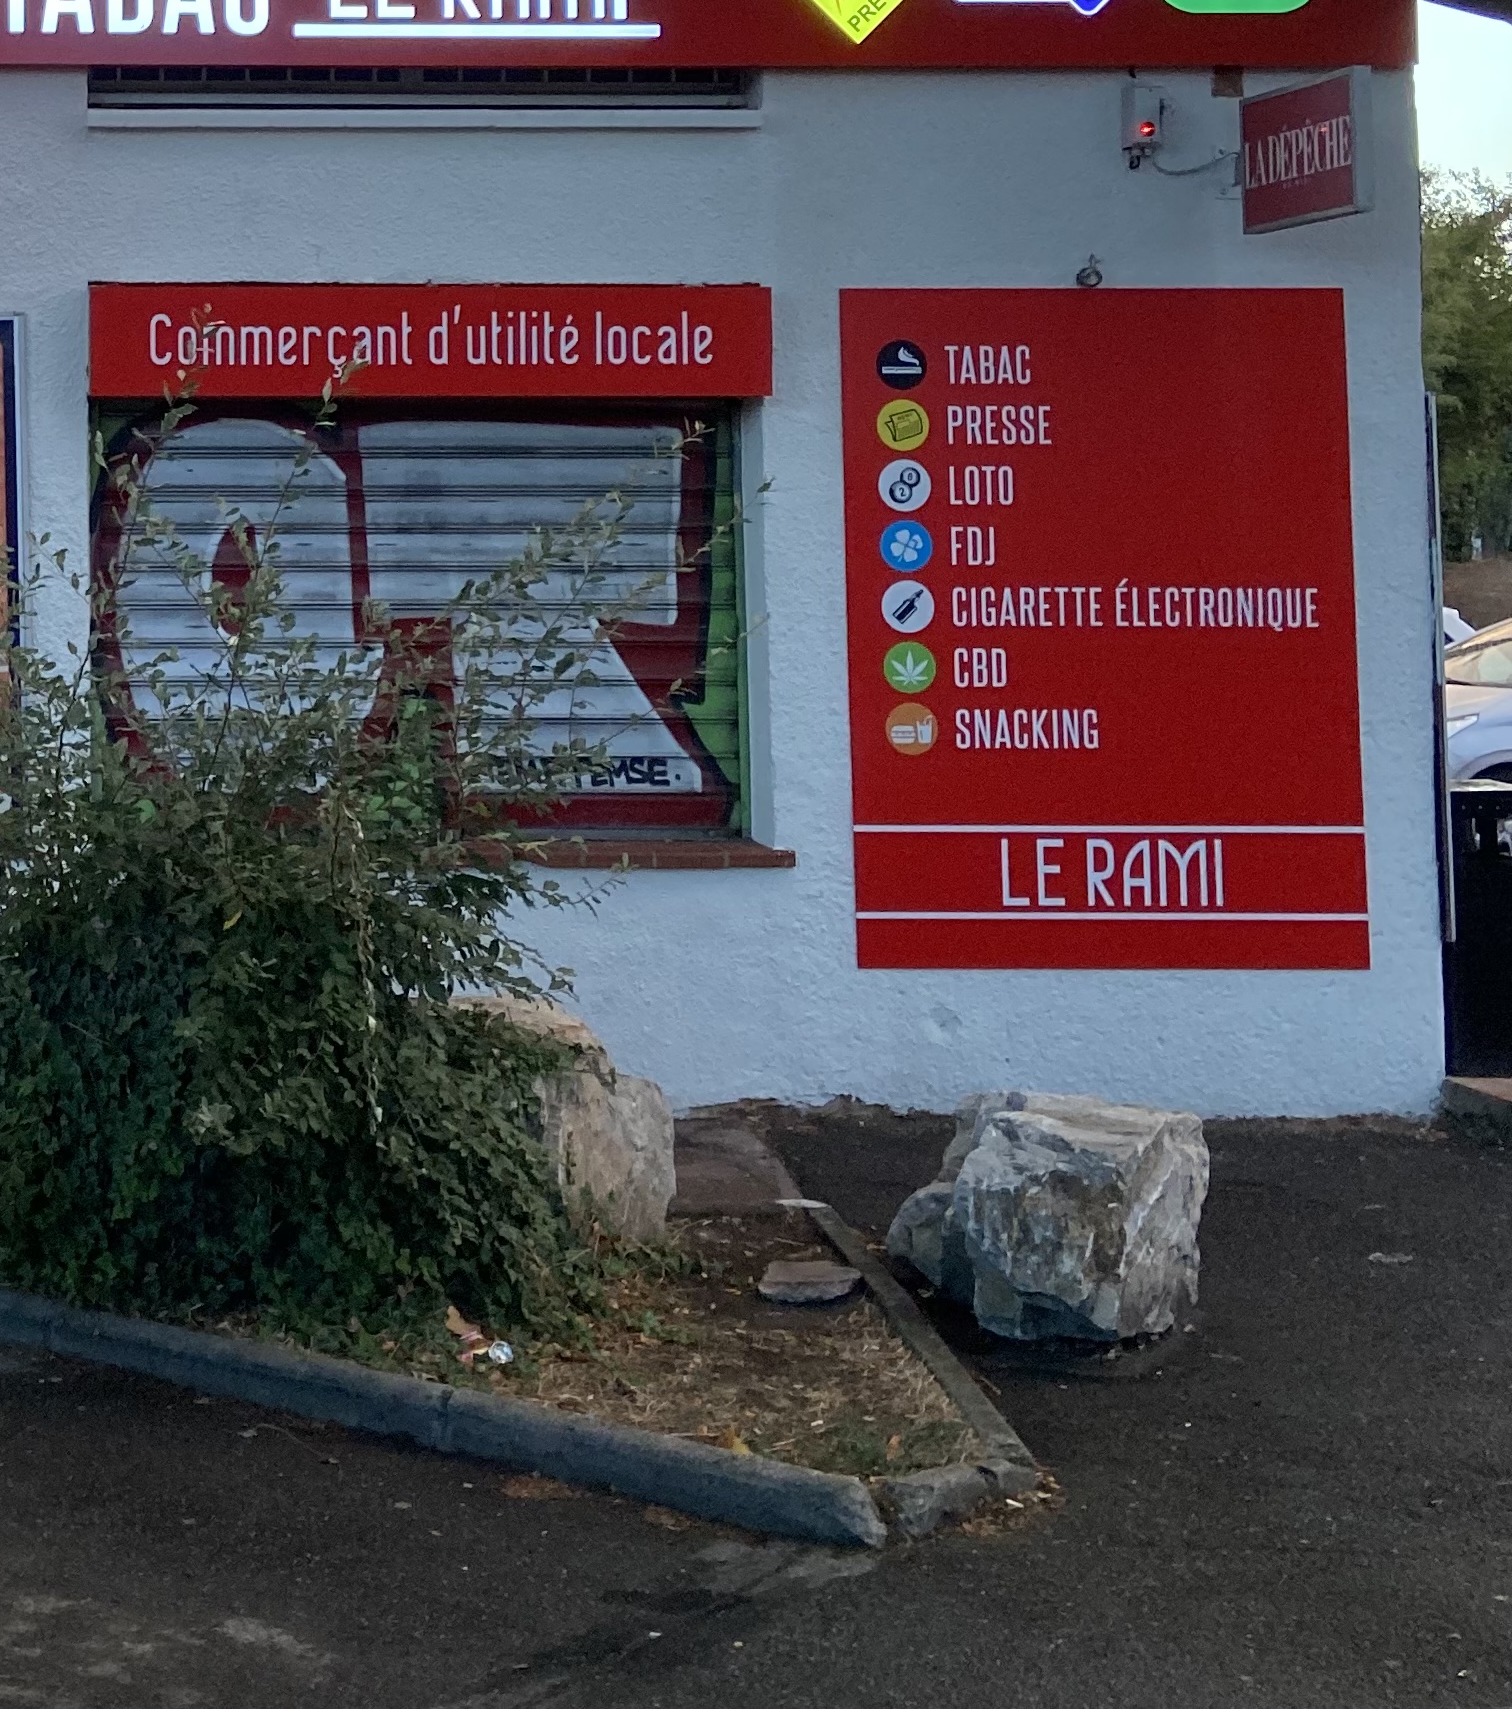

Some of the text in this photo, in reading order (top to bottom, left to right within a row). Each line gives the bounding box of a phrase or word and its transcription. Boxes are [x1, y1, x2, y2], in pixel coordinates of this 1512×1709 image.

[1245, 115, 1352, 189] LA DÉPÊCHE
[149, 304, 714, 378] Commerçant d'utilité locale
[944, 345, 1031, 385] TABAC
[947, 405, 1052, 445] PRESSE
[949, 465, 1014, 506] LOTO
[951, 526, 996, 566] FDJ
[952, 578, 1320, 632] CIGARETTE ÉLECTRONIQUE
[954, 647, 1008, 688] CBD
[955, 709, 1100, 750] SNACKING
[1000, 838, 1224, 907] LE RAMI
